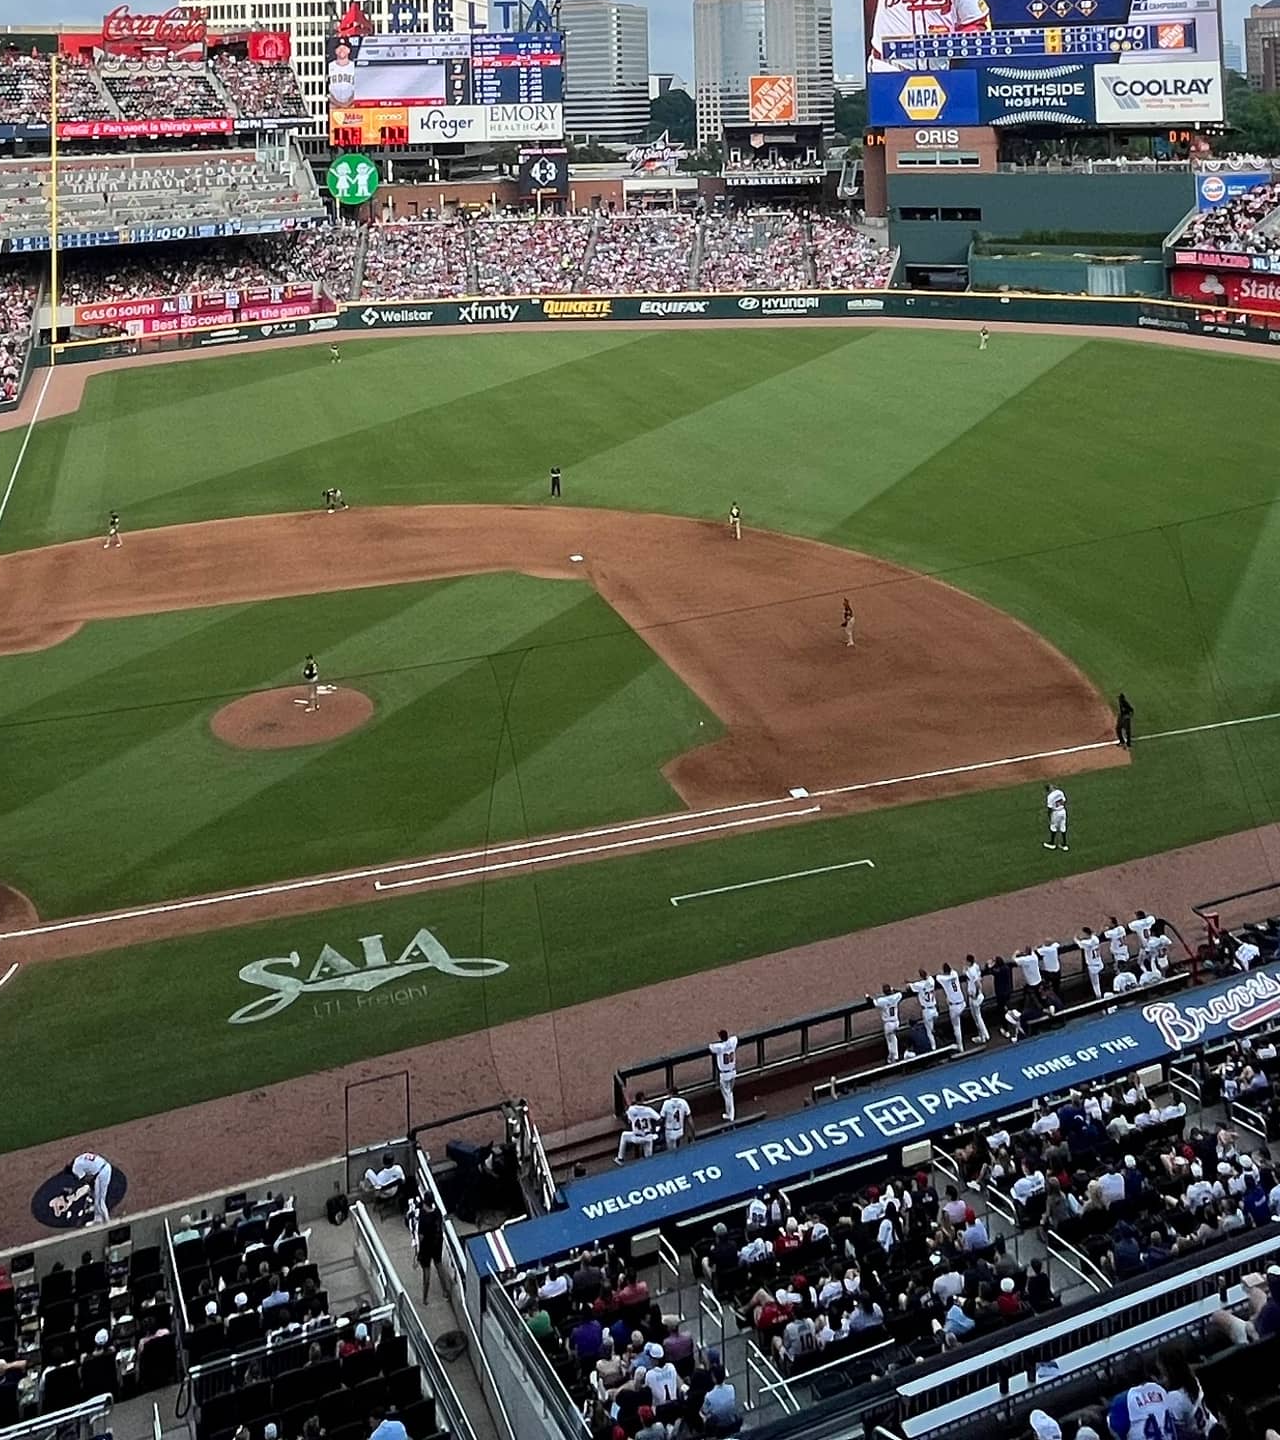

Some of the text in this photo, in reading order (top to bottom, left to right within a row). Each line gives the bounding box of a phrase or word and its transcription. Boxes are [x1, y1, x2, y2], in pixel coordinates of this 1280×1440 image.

[389, 1, 552, 33] DELTA
[987, 83, 1086, 98] NORTHSIDE
[1111, 77, 1214, 97] COOLRAY
[907, 88, 940, 108] NAPA
[1005, 95, 1068, 107] HOSPITAL
[490, 105, 558, 121] EMORY
[103, 122, 122, 132] Fan
[123, 121, 149, 132] work
[159, 121, 198, 134] thirsty
[199, 120, 217, 130] work
[420, 110, 473, 138] Kroger
[915, 130, 959, 144] ORIS
[162, 302, 176, 312] AL
[458, 302, 519, 322] xfinity
[543, 301, 612, 313] QUIKRETE
[639, 301, 707, 316] EQUIFAX
[761, 297, 819, 310] HYUNDAI
[81, 304, 155, 321] GAS SOUTH
[152, 320, 178, 332] Best
[181, 317, 197, 329] 5G
[261, 308, 279, 319] the
[280, 304, 310, 319] game
[381, 310, 433, 322] Wellstar
[229, 928, 510, 1024] SAIA
[356, 985, 430, 1010] Freight
[582, 1177, 691, 1220] WELCOME
[693, 1165, 723, 1185] TO
[735, 1116, 866, 1173] TRUIST
[917, 1072, 1013, 1115] PARK
[1022, 1053, 1077, 1080] HOME
[1076, 1045, 1099, 1065] OF
[1100, 1035, 1139, 1057] THE
[800, 1332, 815, 1353] 10
[1135, 1391, 1163, 1408] AARON
